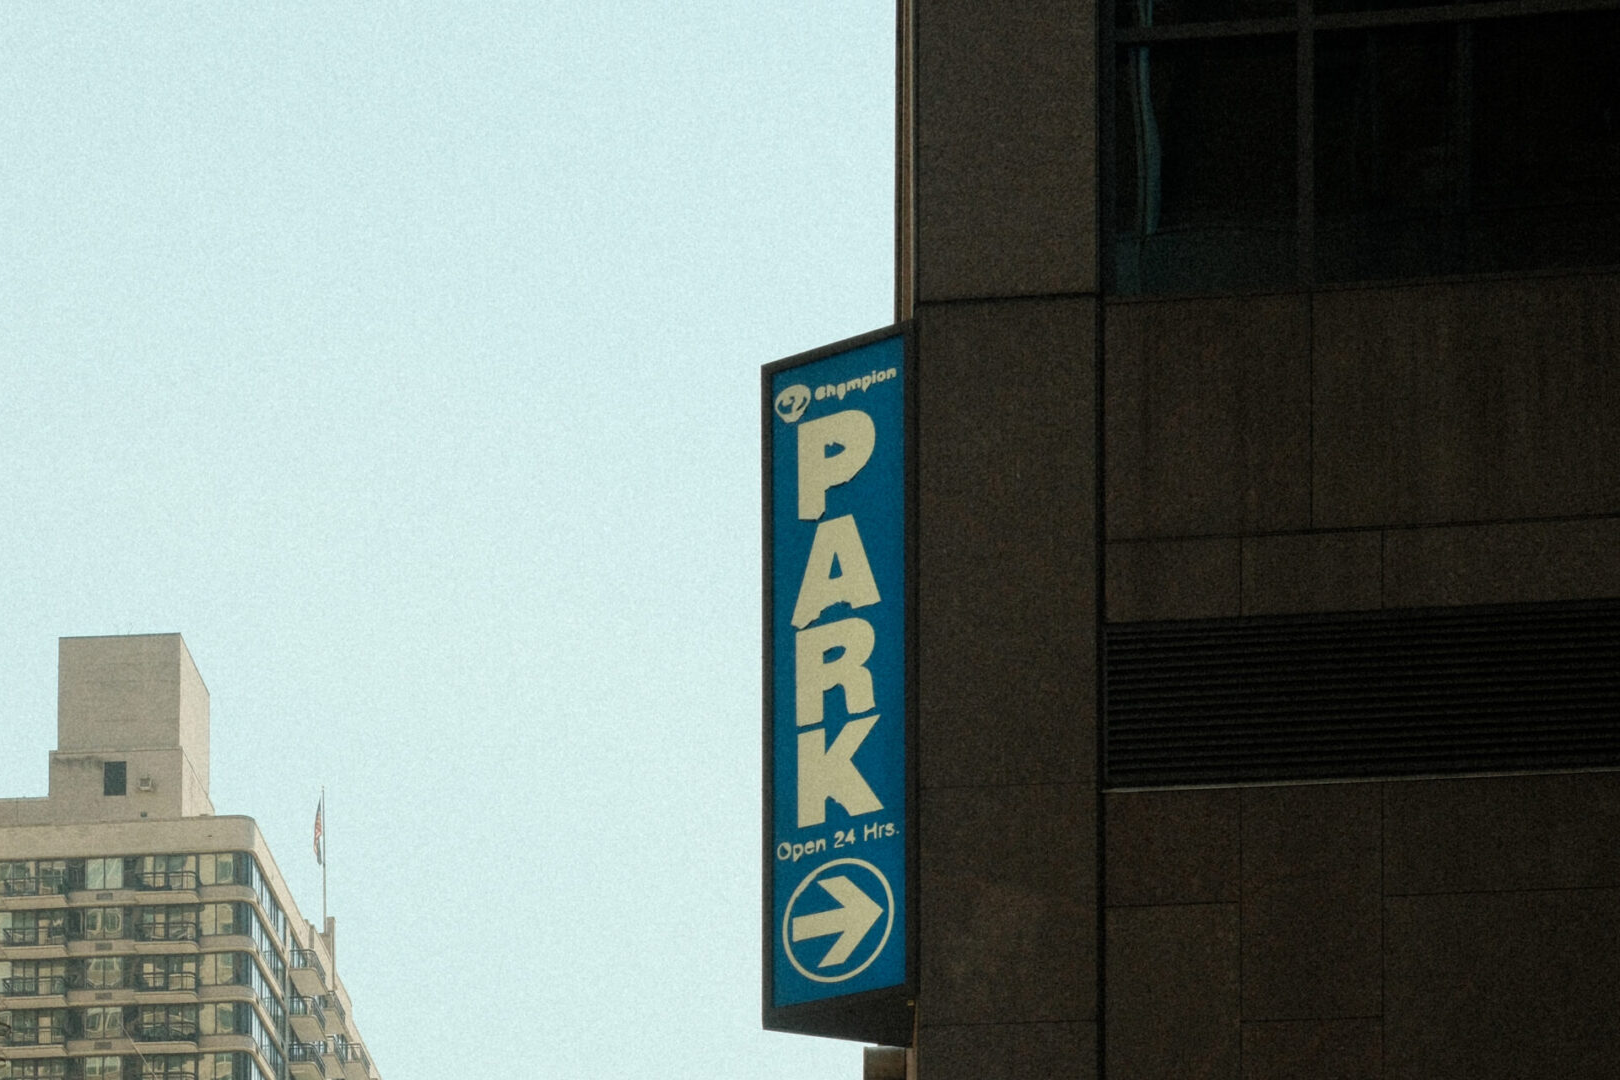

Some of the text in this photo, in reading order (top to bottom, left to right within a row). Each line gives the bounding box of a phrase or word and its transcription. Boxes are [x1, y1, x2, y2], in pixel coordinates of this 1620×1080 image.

[815, 366, 898, 402] Champion
[791, 409, 885, 829] PARK
[776, 822, 901, 864] Open 24 Hrs.
